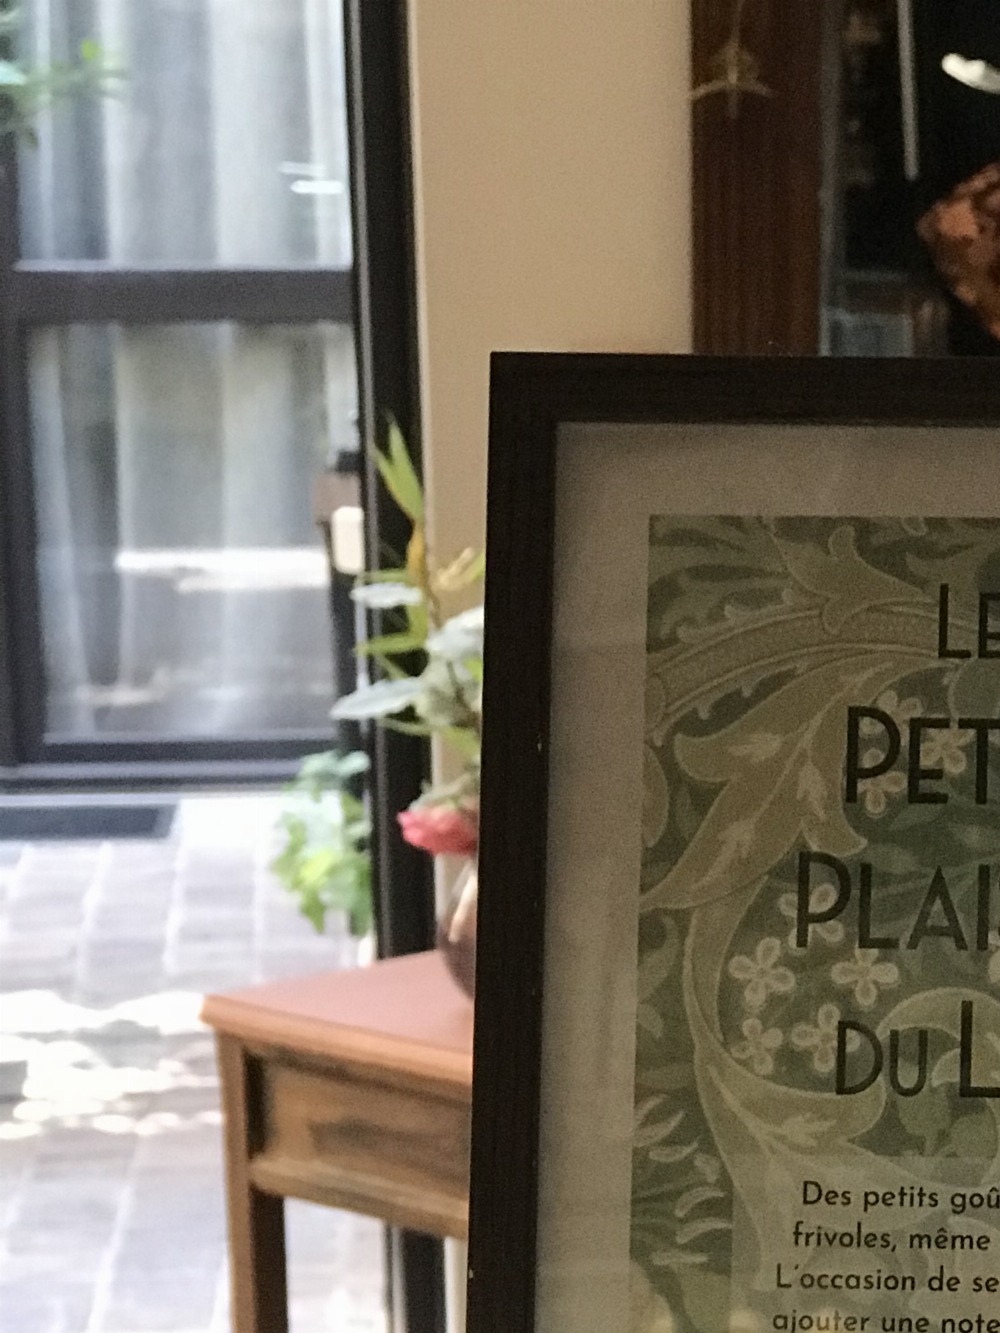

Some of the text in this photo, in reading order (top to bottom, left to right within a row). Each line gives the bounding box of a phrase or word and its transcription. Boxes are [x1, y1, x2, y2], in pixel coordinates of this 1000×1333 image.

[835, 1019, 929, 1097] DU
[803, 1181, 851, 1206] Des
[864, 1186, 938, 1212] petits
[793, 1221, 896, 1252] frivoles,
[910, 1227, 990, 1250] même
[777, 1264, 915, 1291] L'occasion
[928, 1265, 960, 1292] de
[973, 1277, 999, 1293] se
[882, 1317, 929, 1333] une
[941, 1314, 1000, 1333] note
